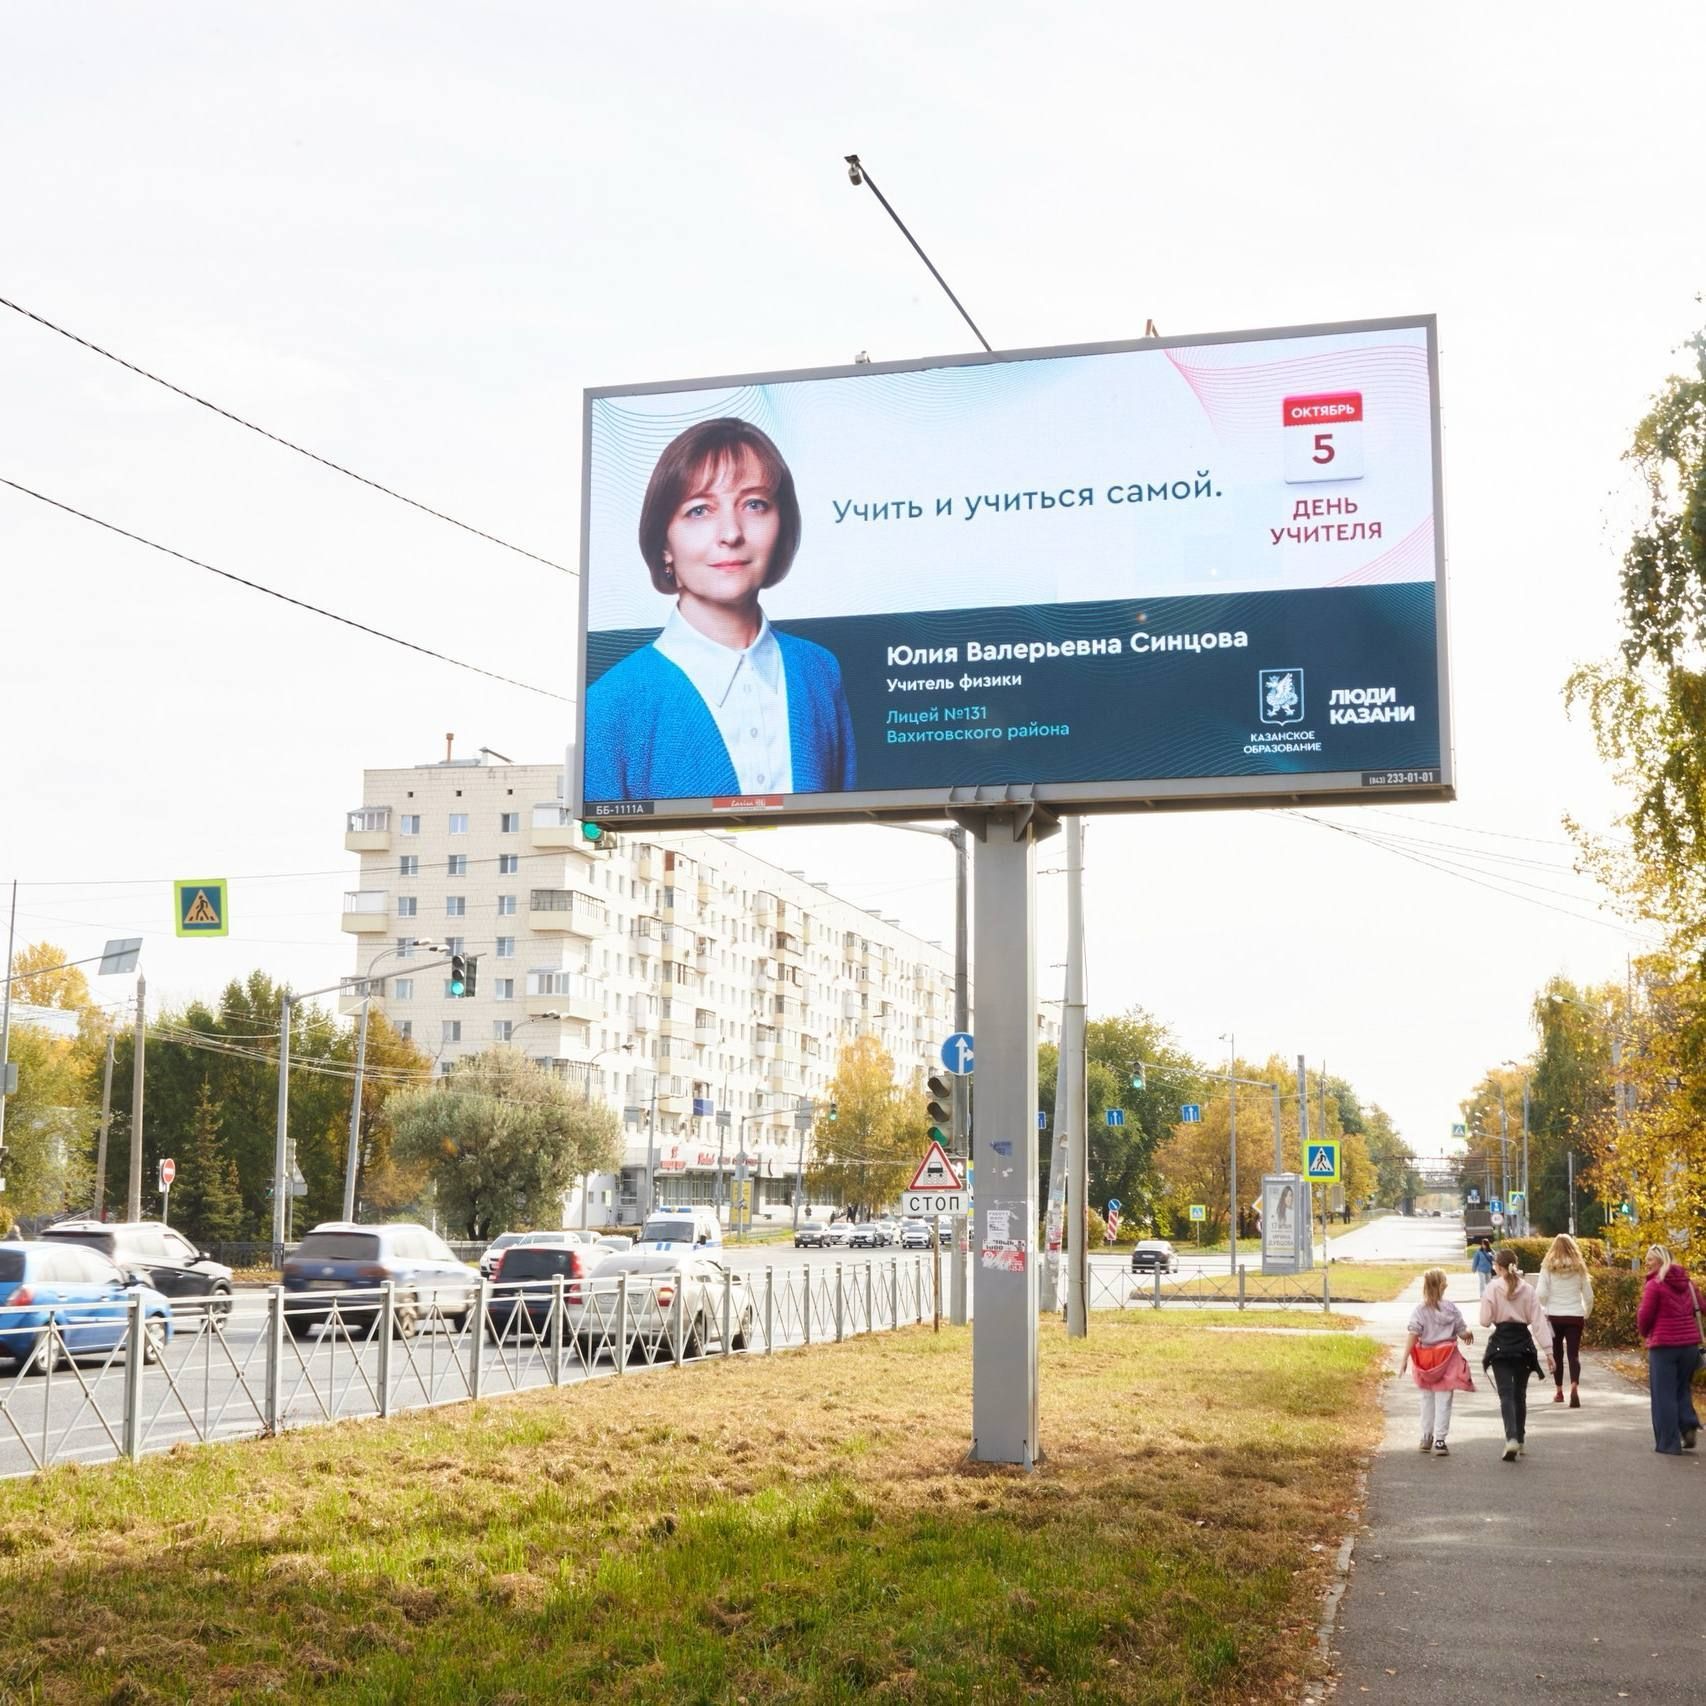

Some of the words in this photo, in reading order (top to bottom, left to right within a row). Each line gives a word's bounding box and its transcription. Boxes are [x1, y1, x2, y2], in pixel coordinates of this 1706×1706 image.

[1291, 404, 1356, 420] ОКТЯБРЬ
[1312, 433, 1336, 465] 5
[832, 498, 923, 524] Учить
[936, 495, 953, 517] и
[964, 485, 1094, 521] учиться
[1106, 469, 1223, 506] самой.
[1292, 497, 1358, 520] ДЕНЬ
[1271, 521, 1382, 546] УЧИТЕЛЯ
[886, 644, 958, 667] Юлия
[966, 637, 1122, 664] Валерьевна
[1129, 629, 1249, 656] Синцова
[886, 677, 954, 694] Учитель
[958, 672, 1022, 693] физики
[1329, 686, 1396, 706] ЛЮДИ
[885, 706, 939, 726] Лицей
[944, 705, 988, 722] №131
[1329, 705, 1416, 725] КАЗАНИ
[886, 728, 1002, 744] Вахитовского
[1007, 722, 1070, 743] района
[1250, 731, 1316, 743] КАЗАНСКОЕ
[1243, 741, 1322, 755] ОБРАЗОВАНИЕ
[1387, 771, 1434, 784] 233-01-01
[595, 805, 645, 816] ББ-1111А
[909, 1196, 960, 1211] СТОП
